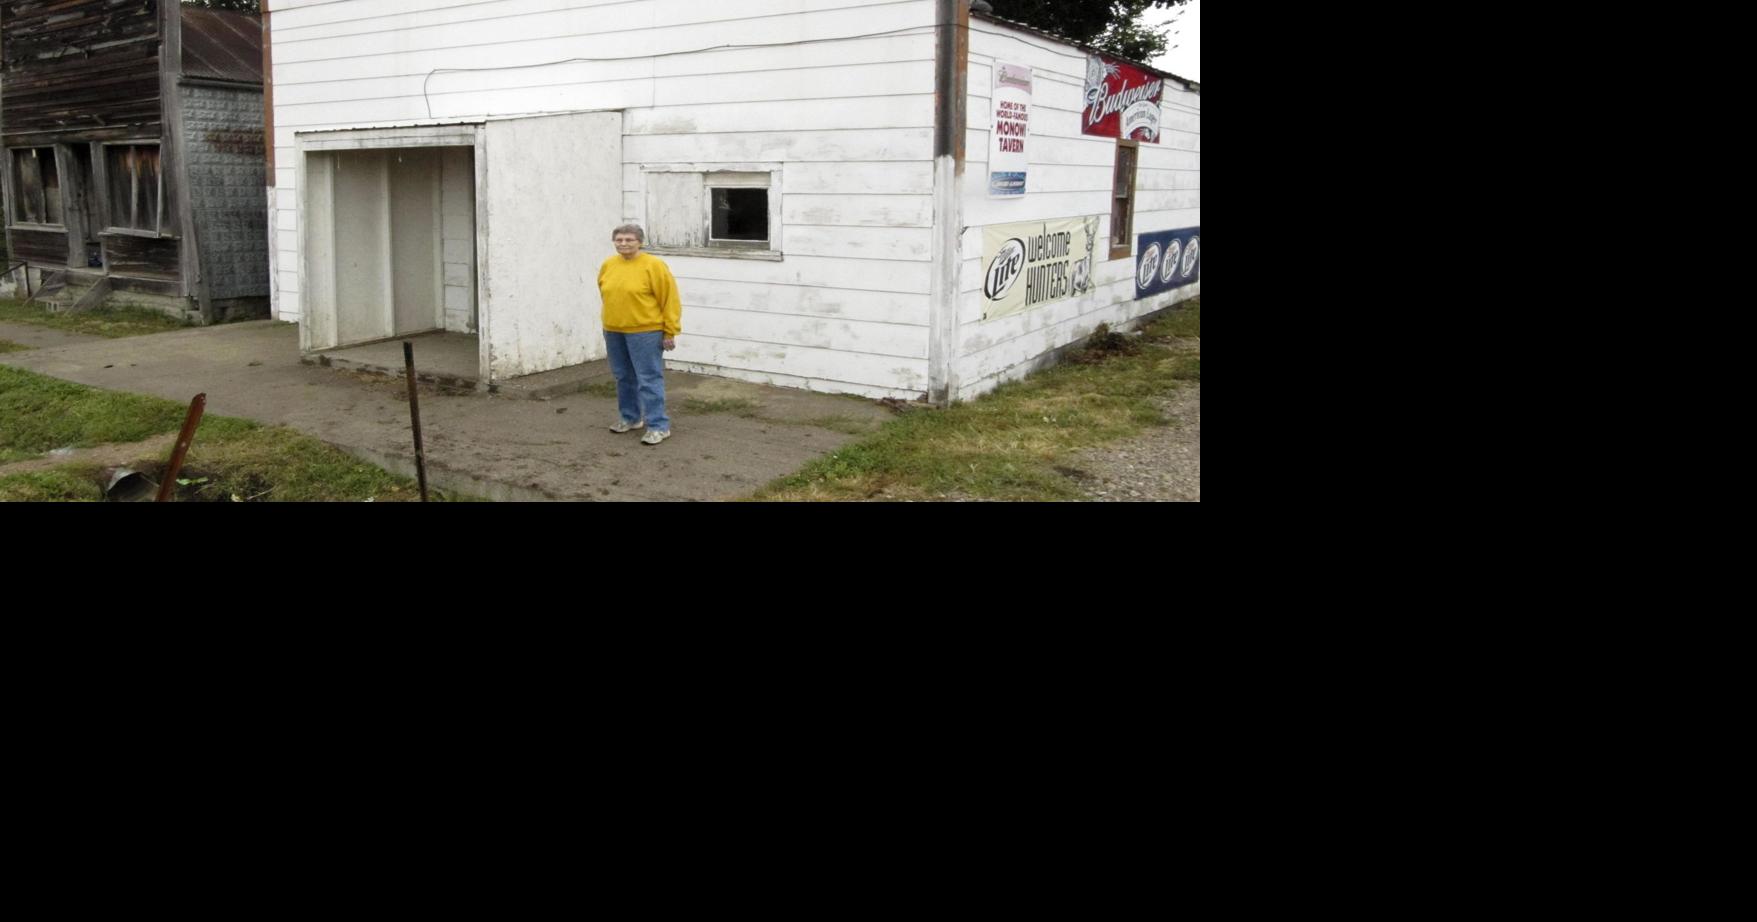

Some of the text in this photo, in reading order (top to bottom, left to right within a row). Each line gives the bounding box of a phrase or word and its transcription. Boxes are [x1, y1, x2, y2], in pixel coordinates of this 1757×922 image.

[1000, 100, 1027, 113] HOME OF THE
[1087, 76, 1162, 126] Budweiser
[996, 120, 1027, 138] MONOWI
[998, 137, 1025, 153] TAVERN
[991, 252, 1021, 298] Lite
[1025, 260, 1069, 306] HUNTERS
